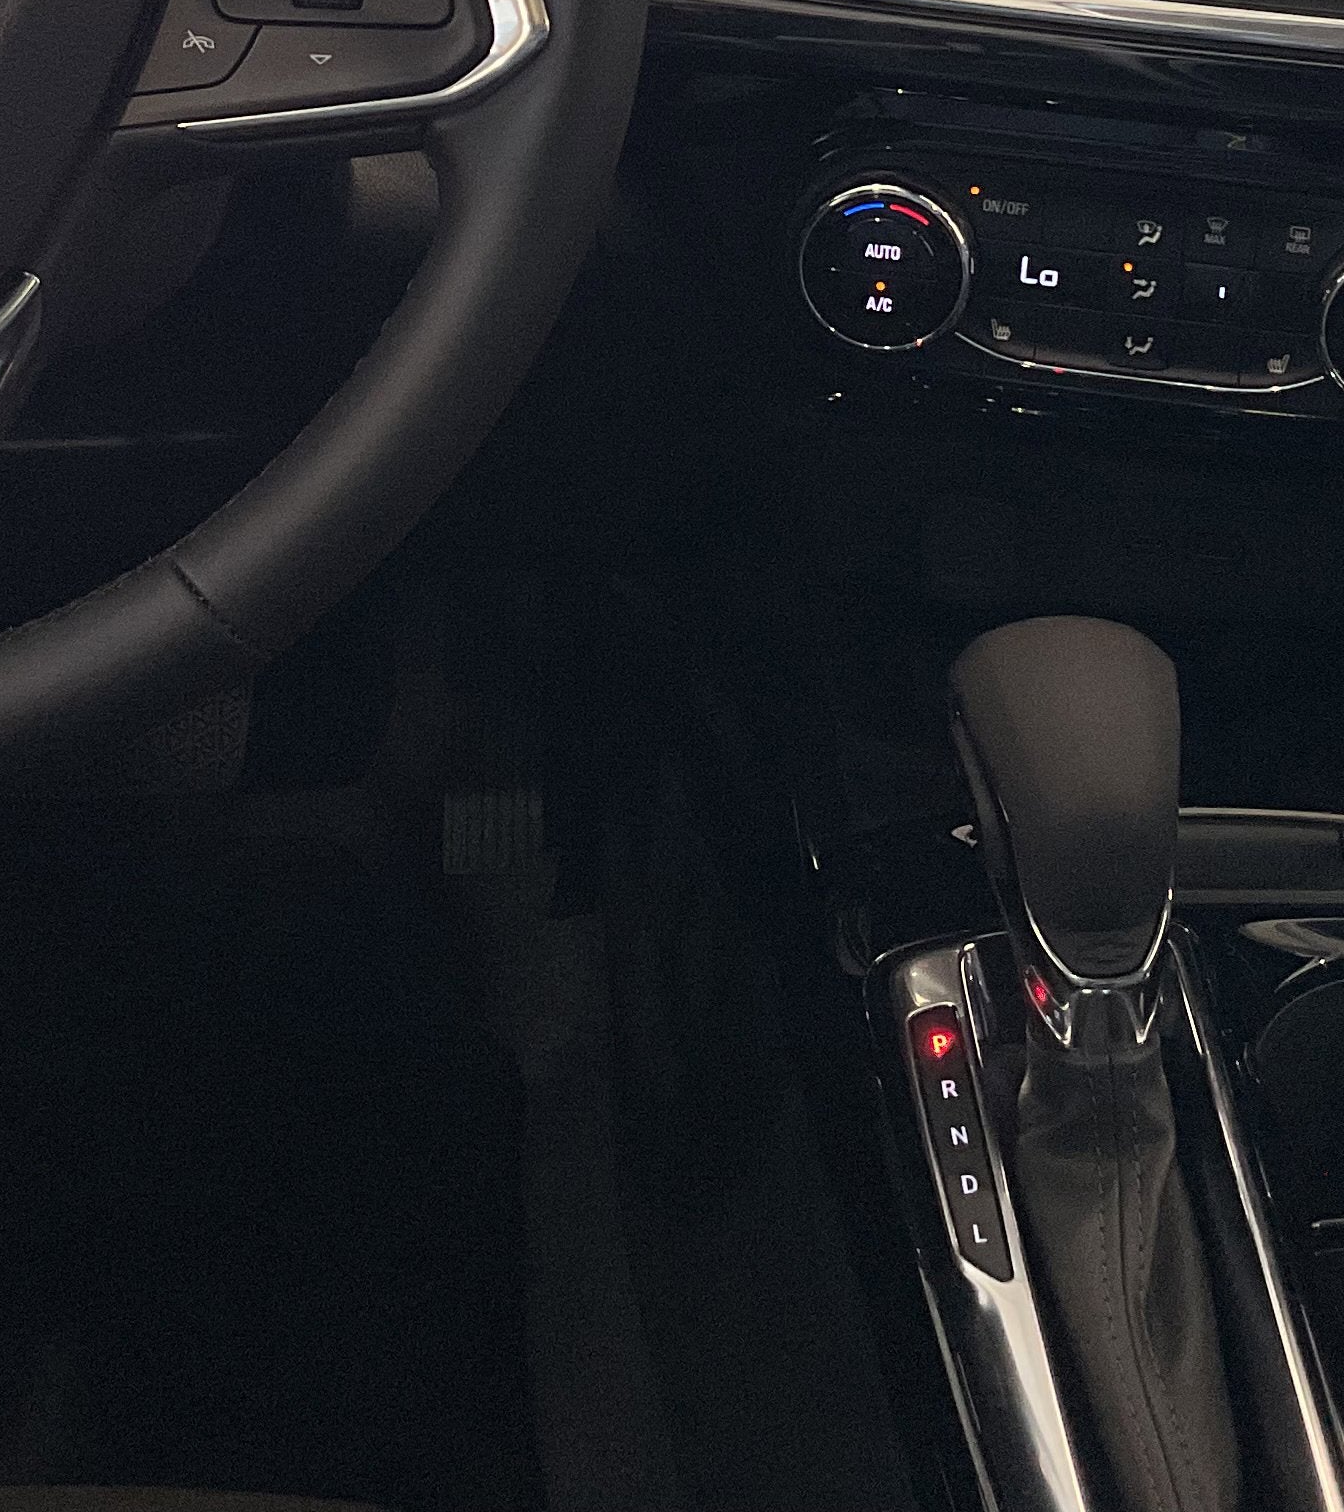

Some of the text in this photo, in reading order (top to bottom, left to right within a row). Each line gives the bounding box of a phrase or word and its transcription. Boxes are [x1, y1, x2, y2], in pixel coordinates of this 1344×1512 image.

[982, 198, 1029, 217] ON/OFF
[865, 244, 900, 260] AUTO
[866, 296, 892, 312] A/C
[941, 1080, 958, 1098] R
[951, 1126, 968, 1145] N
[961, 1175, 978, 1194] D
[973, 1224, 987, 1243] L
